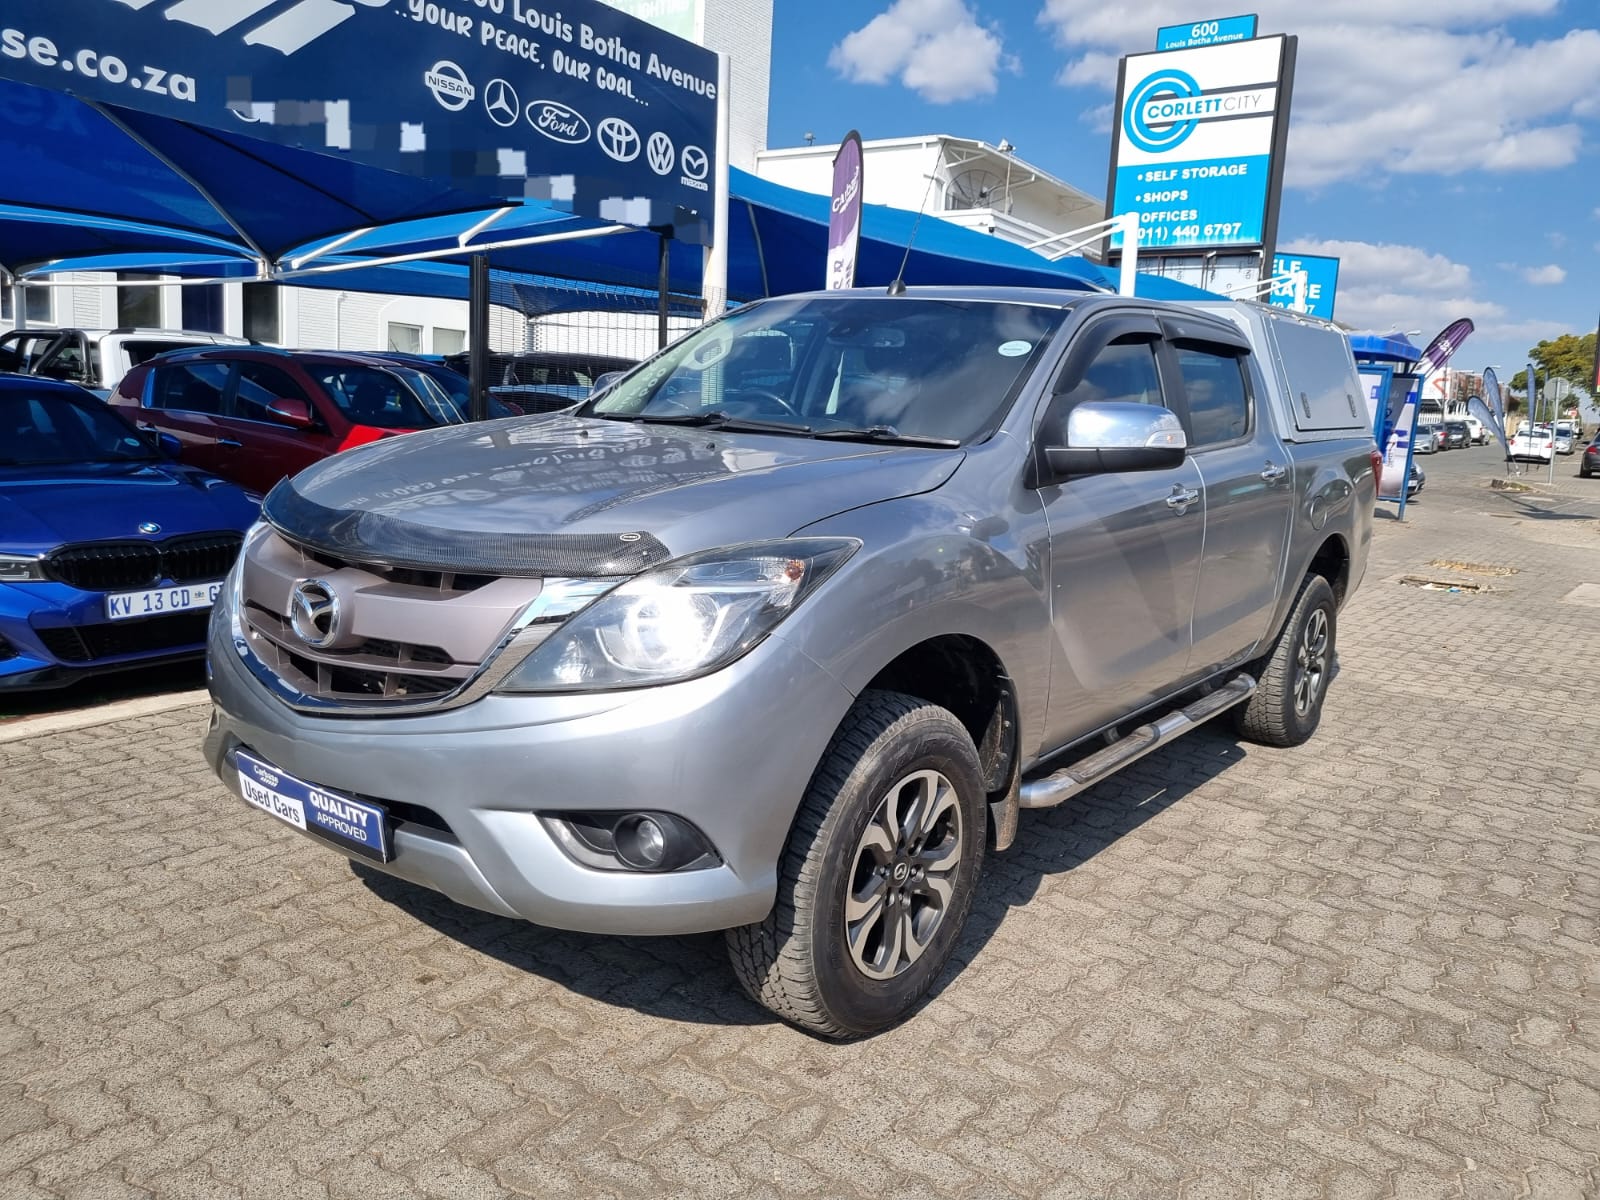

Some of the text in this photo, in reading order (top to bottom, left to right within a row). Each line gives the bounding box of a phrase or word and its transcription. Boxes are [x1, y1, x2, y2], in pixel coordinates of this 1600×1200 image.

[1165, 33, 1244, 49] Louis Botha Avenue
[1191, 22, 1219, 38] 600
[514, 0, 716, 99] Louis Botha Avenue
[1, 28, 196, 102] se.co.za
[552, 49, 591, 82] OUR
[428, 75, 472, 97] NISSAN
[538, 106, 580, 137] Ford
[1145, 164, 1248, 182] SELF STORAGE
[1143, 190, 1189, 203] SHOPS
[1141, 210, 1198, 223] OFFICES
[1172, 224, 1200, 238] 440
[1203, 222, 1242, 237] 6797
[1270, 281, 1321, 299] RAE
[109, 596, 132, 617] KV
[143, 592, 164, 612] 13
[170, 587, 190, 608] CD
[243, 780, 300, 823] Used Cars
[309, 791, 368, 827] QUALITY
[317, 812, 367, 841] APPROVED
